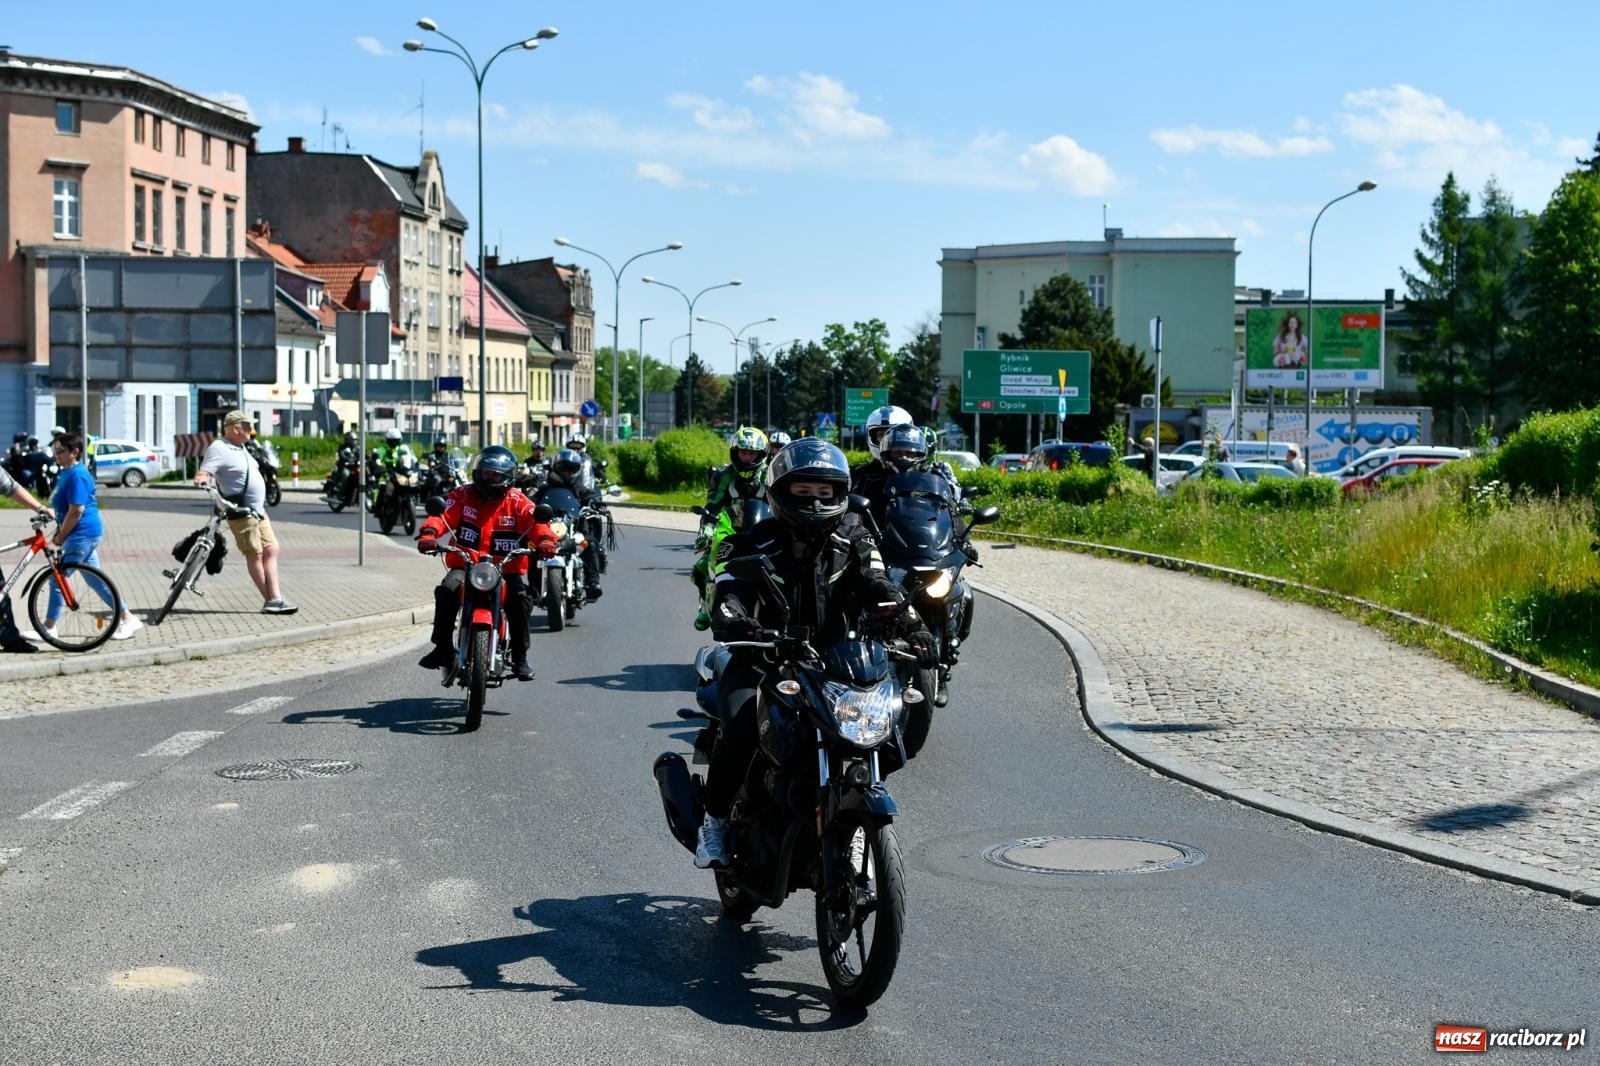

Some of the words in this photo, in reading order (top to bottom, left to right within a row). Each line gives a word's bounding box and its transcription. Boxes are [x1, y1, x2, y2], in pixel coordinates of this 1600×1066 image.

[1000, 353, 1030, 363] Rybnik
[1000, 364, 1033, 373] Gliwice
[1000, 401, 1027, 410] Opole
